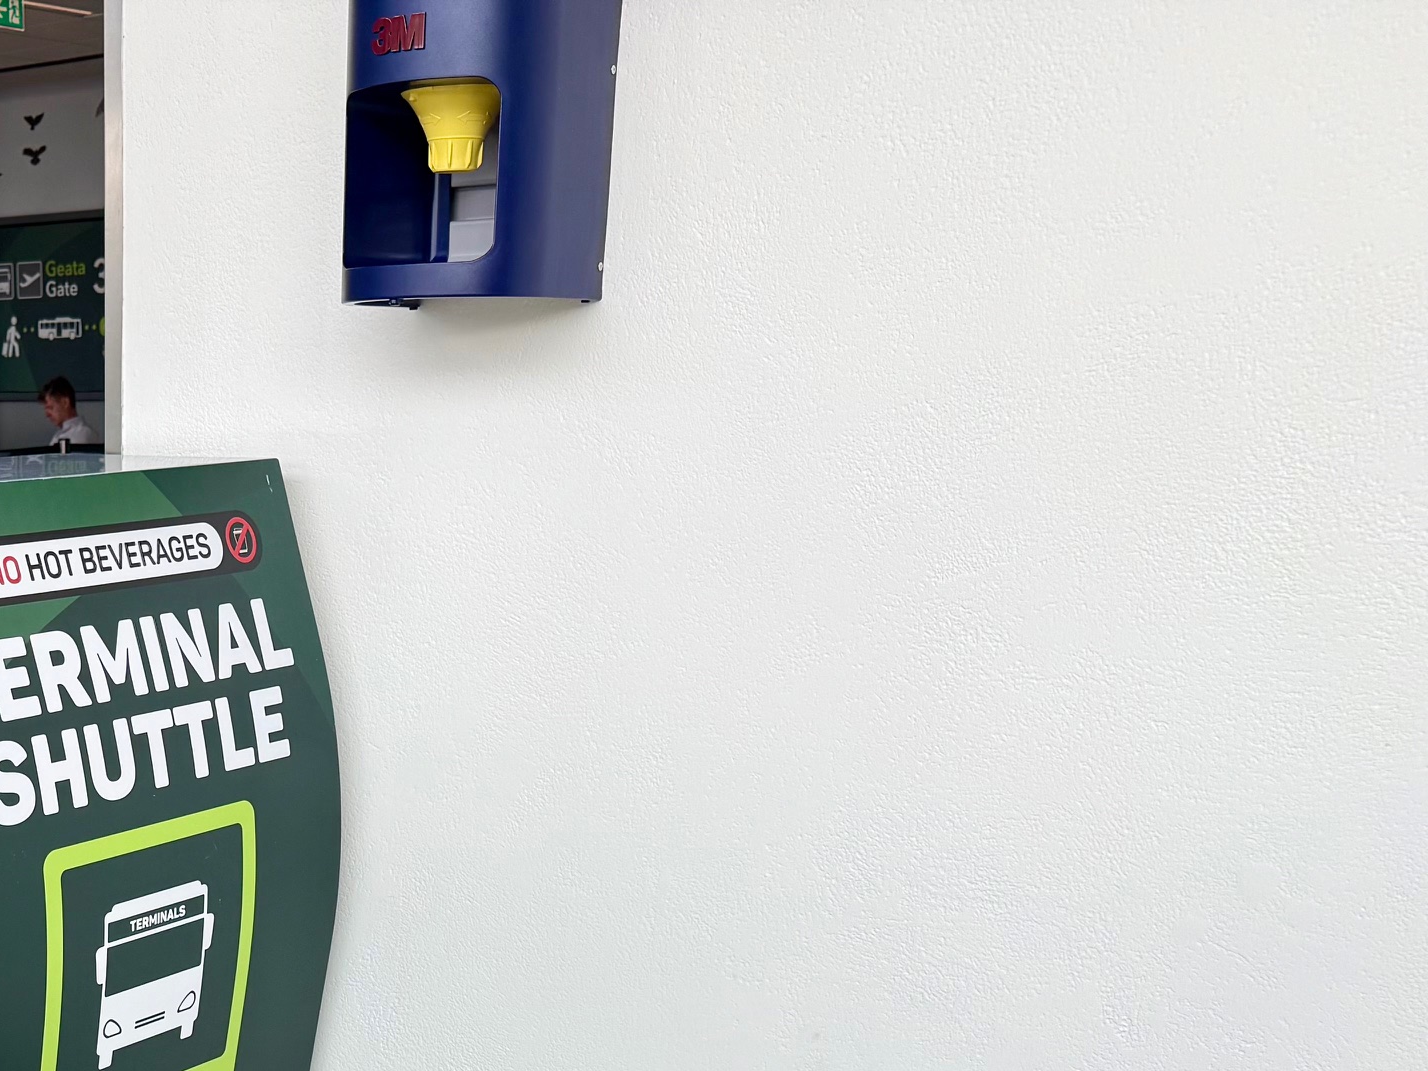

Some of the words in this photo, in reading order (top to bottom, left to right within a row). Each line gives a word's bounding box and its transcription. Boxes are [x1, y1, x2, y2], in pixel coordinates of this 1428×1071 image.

[371, 12, 427, 55] 3M
[45, 260, 86, 277] Geata
[45, 281, 79, 297] Gate
[25, 549, 74, 582] HOT
[79, 532, 212, 575] BEVERAGES
[129, 904, 186, 933] TERMINALS
